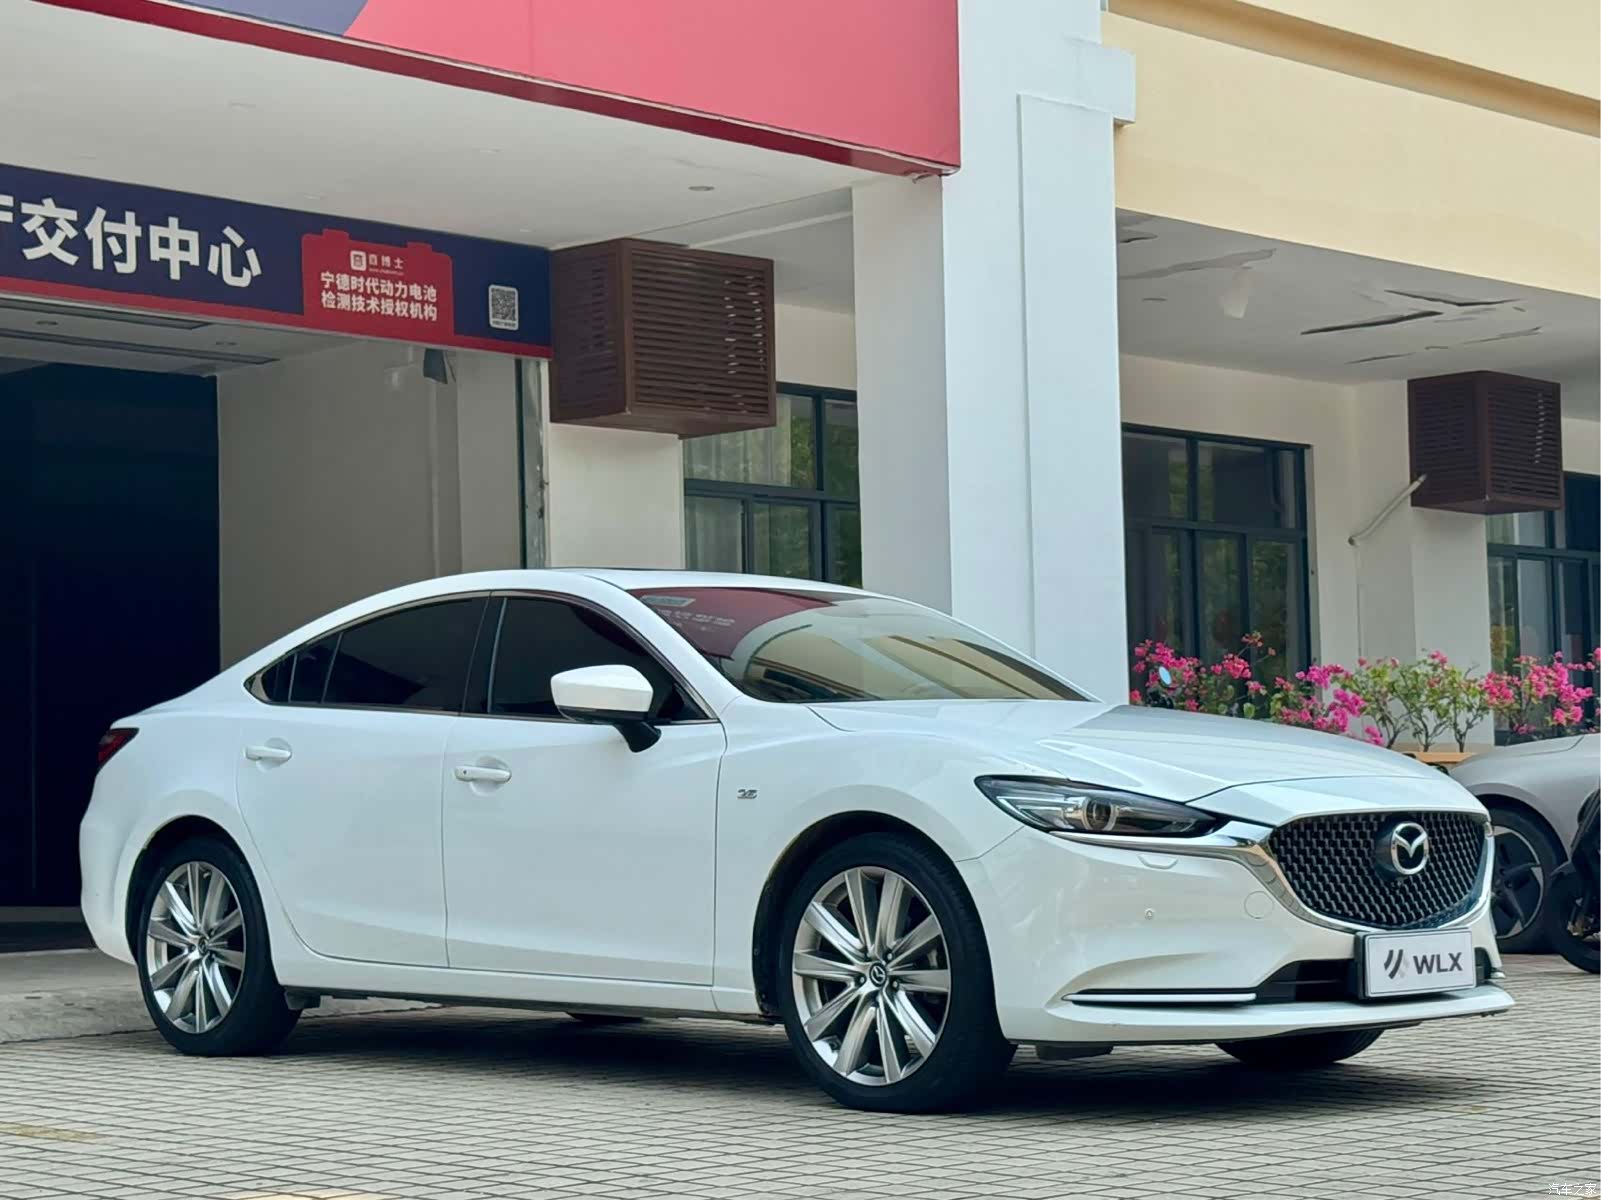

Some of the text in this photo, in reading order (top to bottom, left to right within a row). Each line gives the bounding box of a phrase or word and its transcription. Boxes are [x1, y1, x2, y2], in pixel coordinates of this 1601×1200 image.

[0, 194, 262, 288] 交付中心
[320, 270, 437, 303] 宁德时代动力电池
[320, 290, 438, 322] 检测技术授权机构
[1412, 951, 1463, 975] WLX
